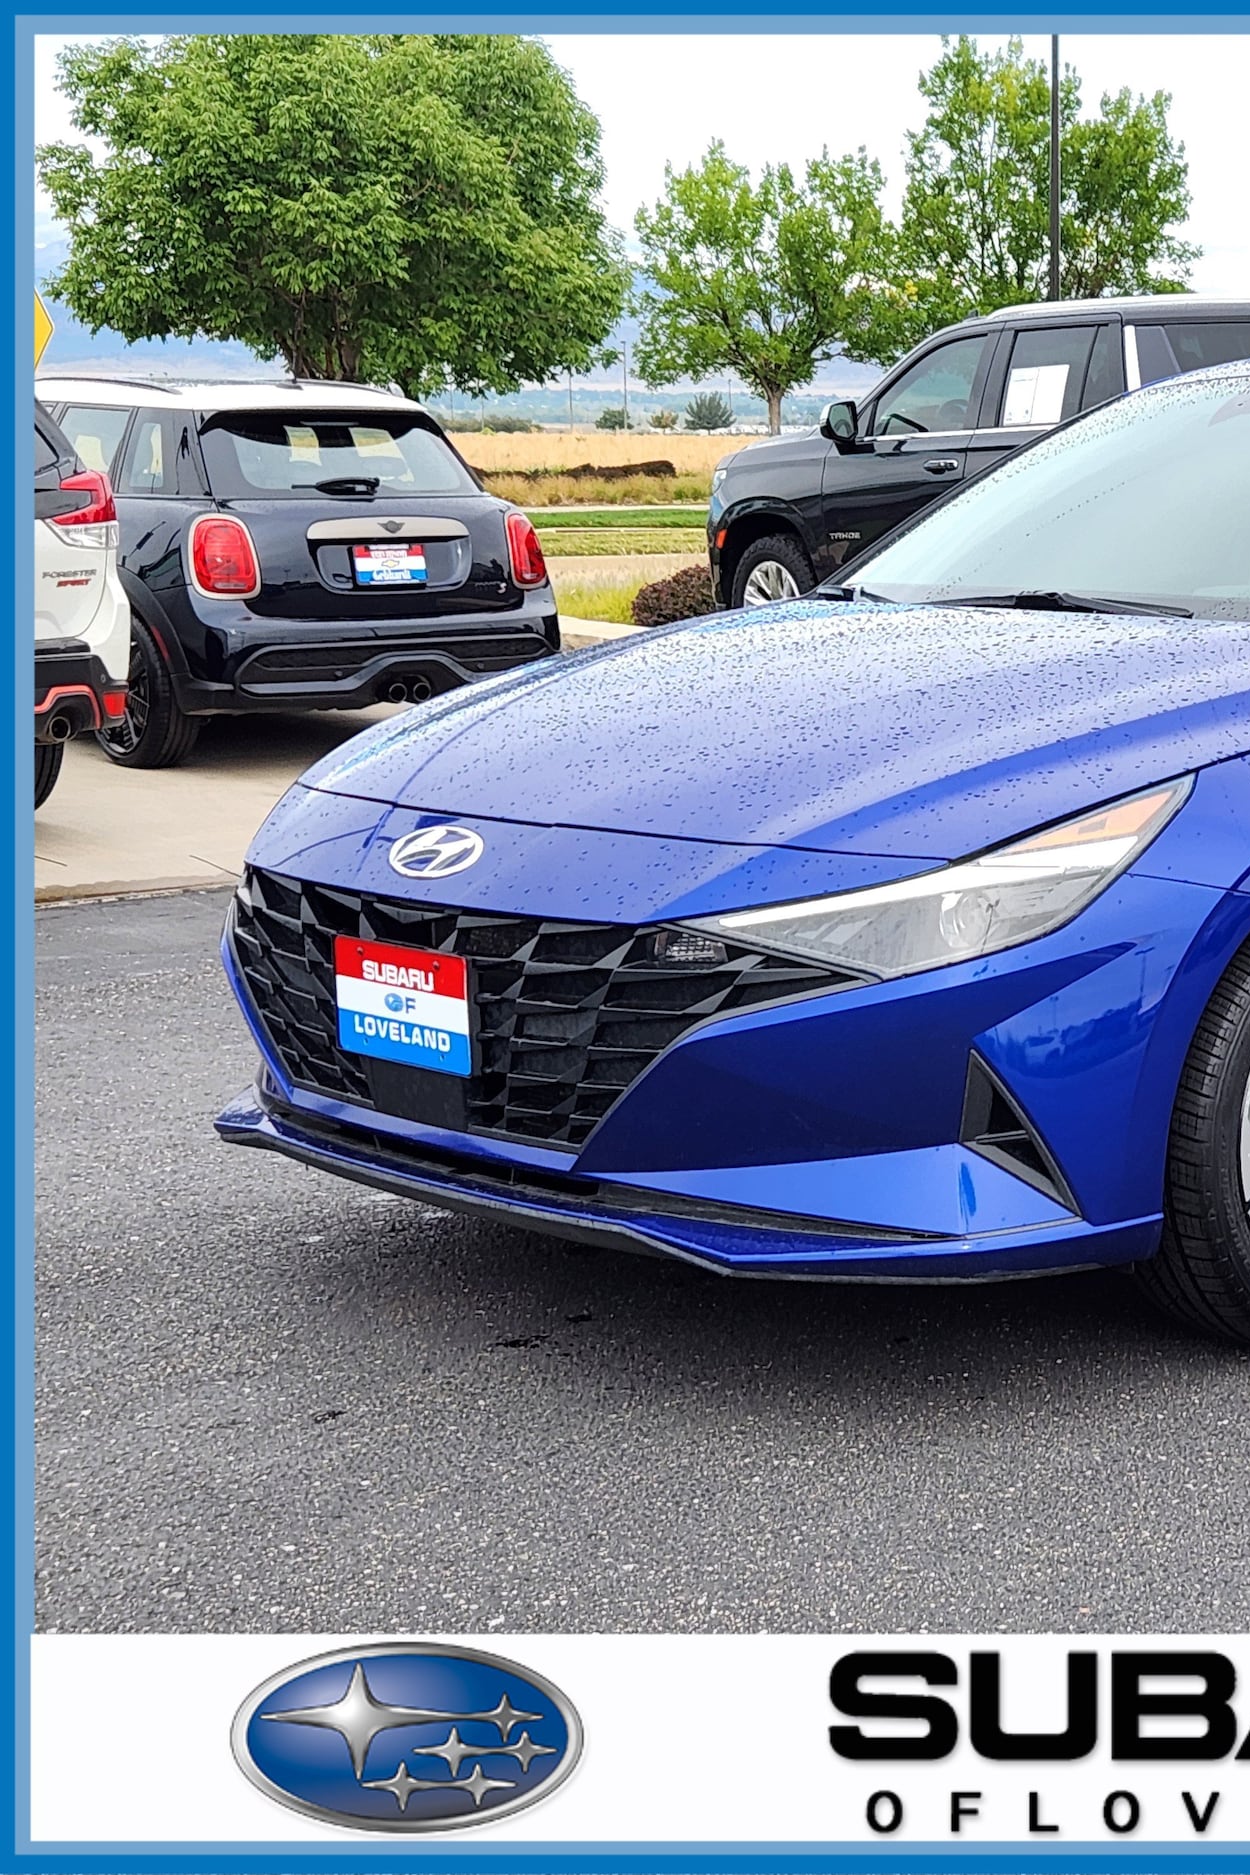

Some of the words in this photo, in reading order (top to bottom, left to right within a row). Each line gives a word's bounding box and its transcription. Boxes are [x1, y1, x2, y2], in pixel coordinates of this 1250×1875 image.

[828, 531, 861, 540] TAHOE
[42, 569, 97, 579] FORESTER
[361, 959, 435, 992] SUBARU
[354, 1014, 450, 1052] LOVELAND
